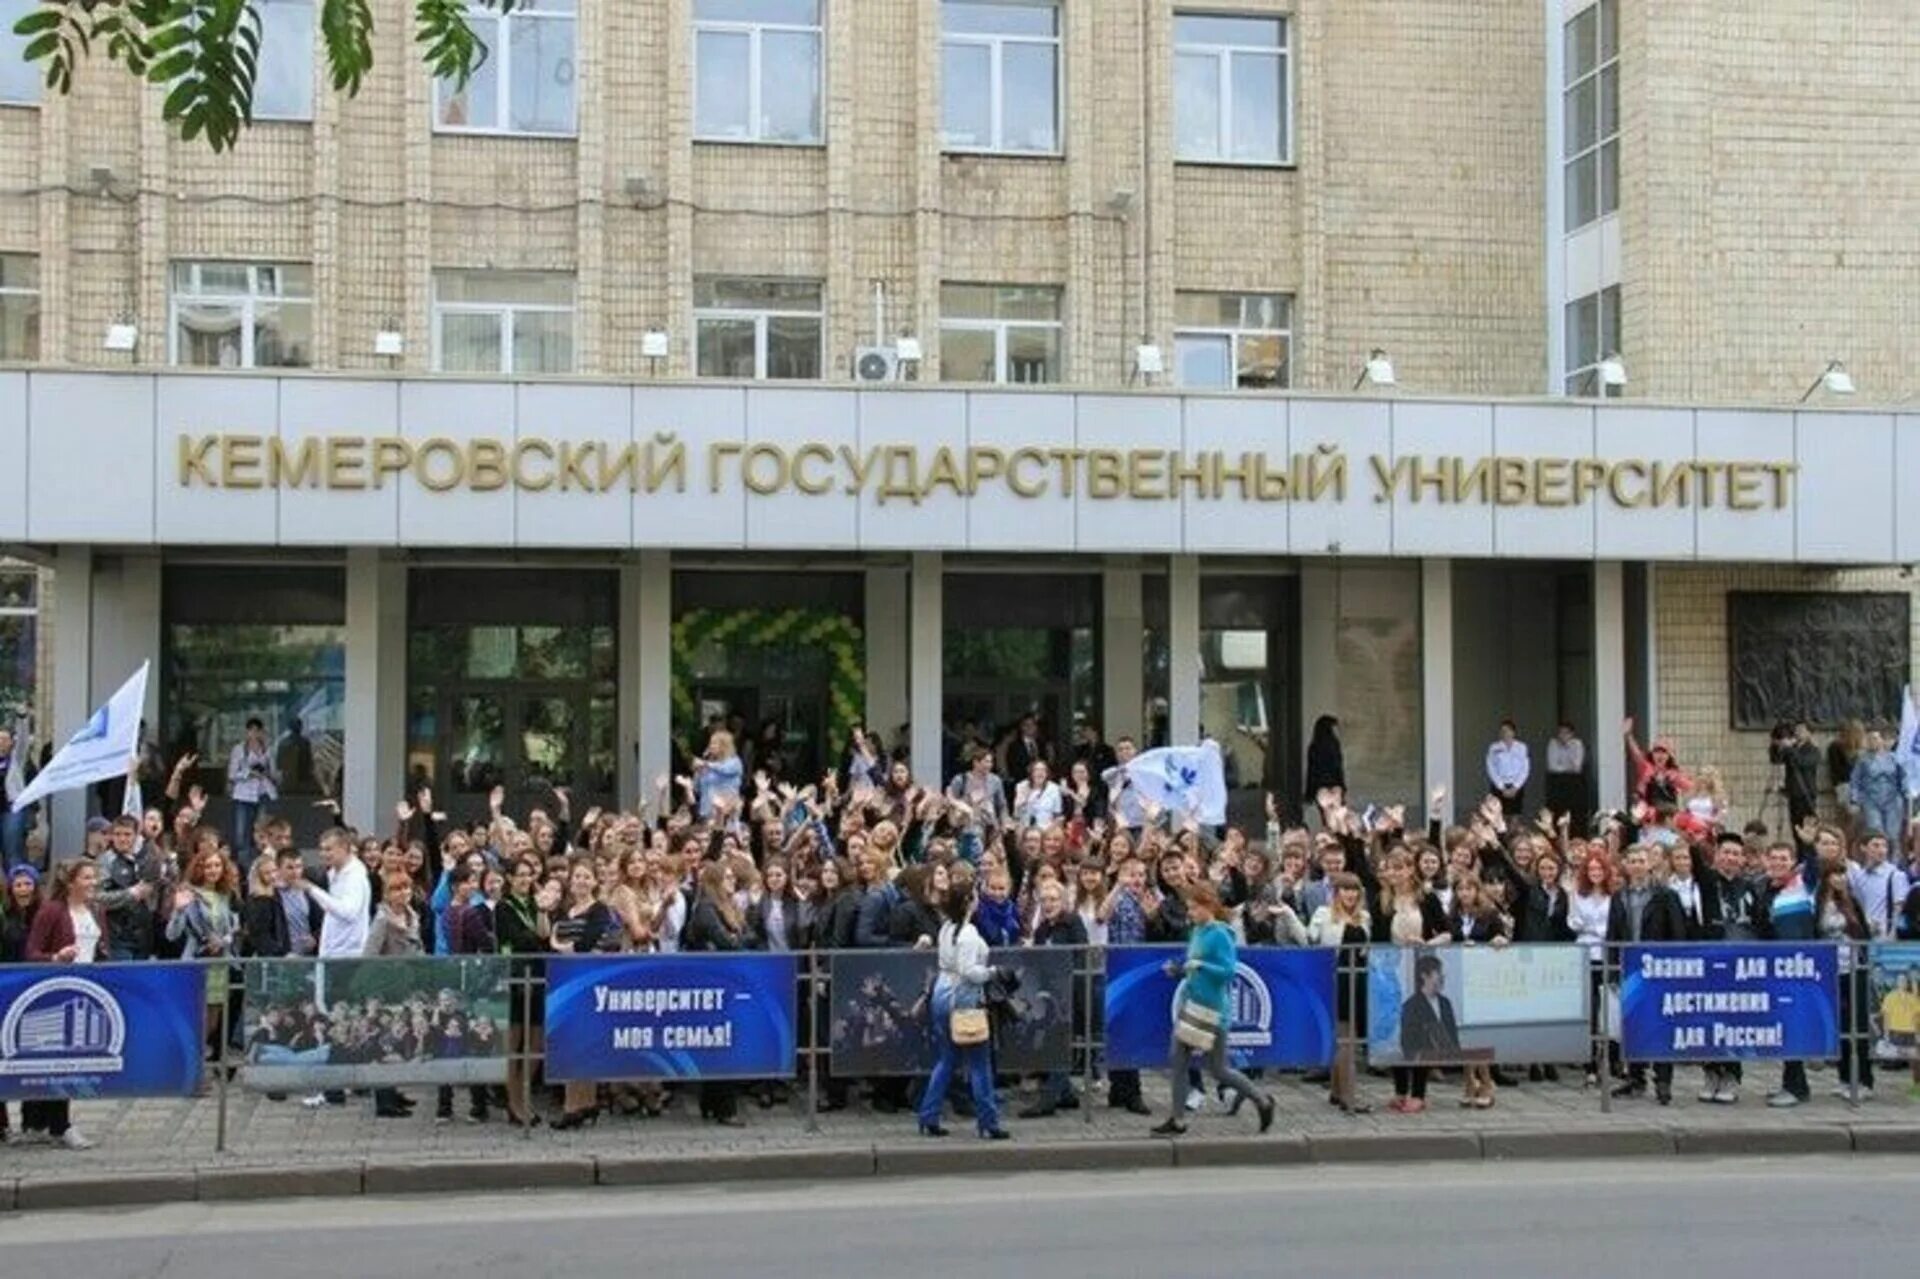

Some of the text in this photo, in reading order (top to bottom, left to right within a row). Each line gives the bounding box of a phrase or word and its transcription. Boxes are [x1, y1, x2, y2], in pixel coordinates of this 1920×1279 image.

[177, 432, 1798, 510] КЕМЕРОВСКИЙ ГОСУДАРСТВЕННЫЙ УНИВЕРСИТЕТ
[1641, 954, 1704, 978] Знания
[1735, 957, 1767, 980] для
[1774, 952, 1821, 981] себя,
[594, 986, 725, 1017] Университет
[1662, 992, 1769, 1015] достижения
[614, 1021, 732, 1049] моя семья!
[1673, 1021, 1783, 1050] для России!
